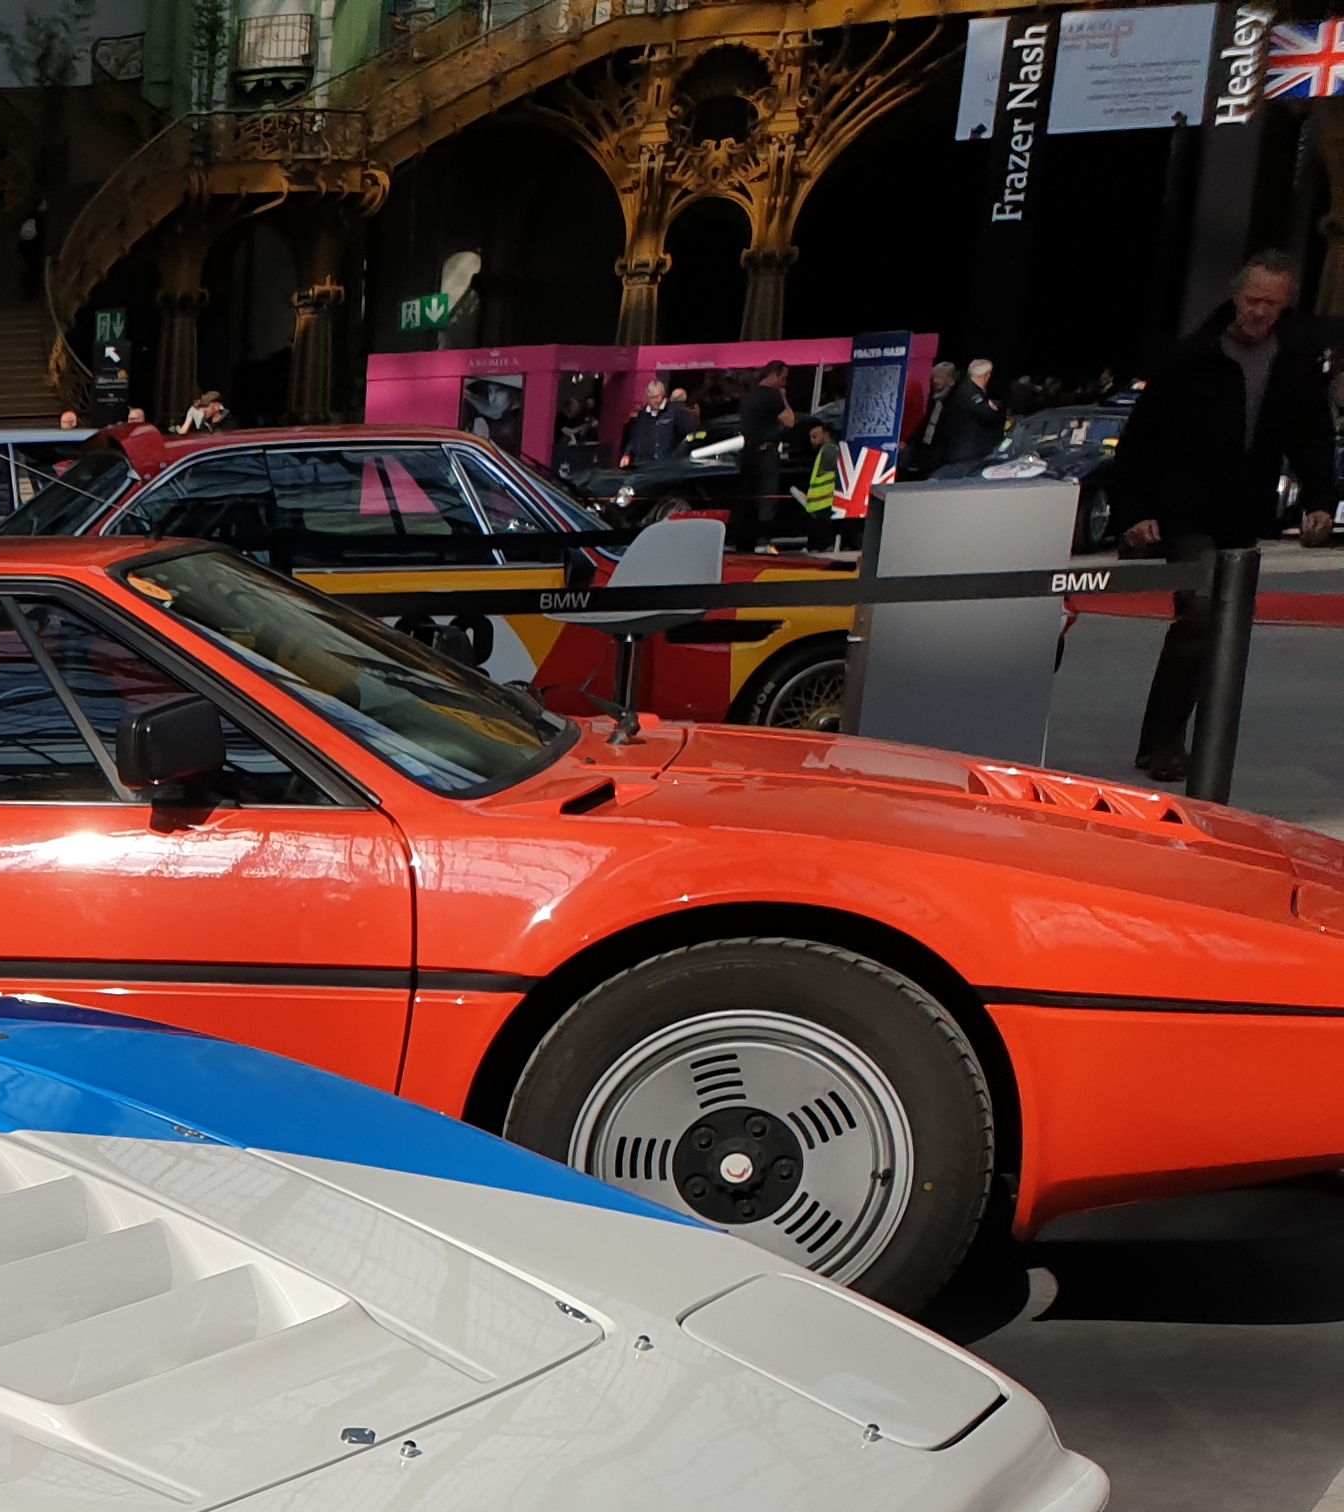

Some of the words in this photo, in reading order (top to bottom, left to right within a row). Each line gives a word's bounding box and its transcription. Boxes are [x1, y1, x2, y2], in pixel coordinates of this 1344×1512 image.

[1006, 23, 1049, 111] Nash
[1214, 3, 1277, 127] Healey
[991, 118, 1036, 223] Frazer
[539, 591, 591, 609] BMW
[1051, 572, 1110, 594] BMW
